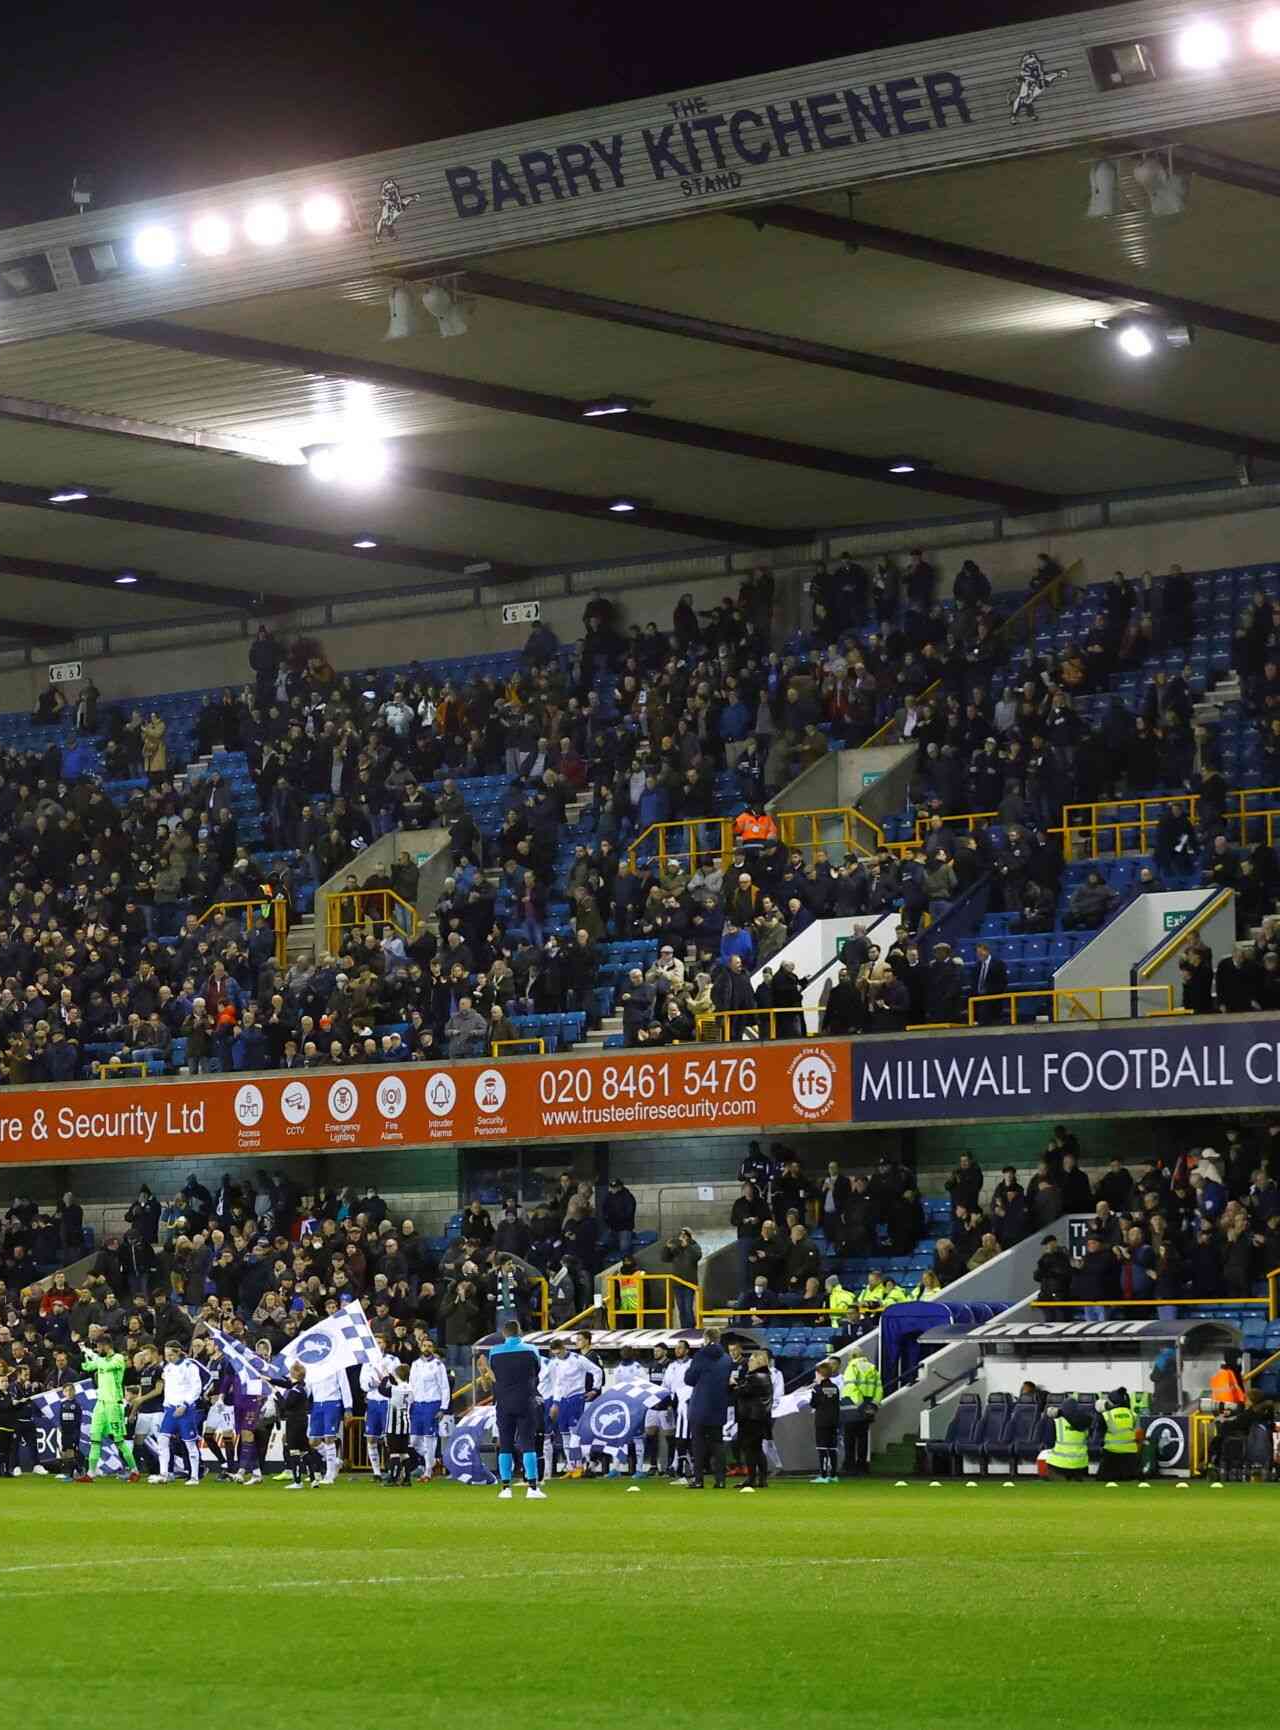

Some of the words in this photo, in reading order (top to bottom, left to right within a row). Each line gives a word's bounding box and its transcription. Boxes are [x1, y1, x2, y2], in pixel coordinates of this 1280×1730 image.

[667, 97, 708, 119] THE
[445, 135, 626, 219] BARRY
[641, 71, 972, 181] KITCHENER
[680, 171, 742, 198] STAND
[861, 1055, 1031, 1101] MILLWALL
[1044, 1045, 1233, 1093] FOOTBALL
[540, 1069, 592, 1105] 020
[602, 1063, 670, 1099] 8461
[683, 1057, 757, 1093] 5476
[798, 1070, 828, 1096] tfs
[542, 1099, 756, 1126] www.trusteefiresecurity.com
[30, 1108, 48, 1139] &
[57, 1103, 158, 1142] Security
[166, 1101, 205, 1134] Ltd
[385, 1121, 398, 1131] Fire
[428, 1119, 454, 1129] Intruder
[478, 1116, 504, 1127] Security
[238, 1129, 260, 1137] Access
[286, 1126, 305, 1136] CCTV
[324, 1123, 361, 1134] Emergency
[430, 1128, 453, 1138] Alarms
[474, 1125, 508, 1136] Personnel
[330, 1133, 355, 1144] Lighting
[380, 1132, 404, 1141] Alarms
[238, 1138, 260, 1148] Control
